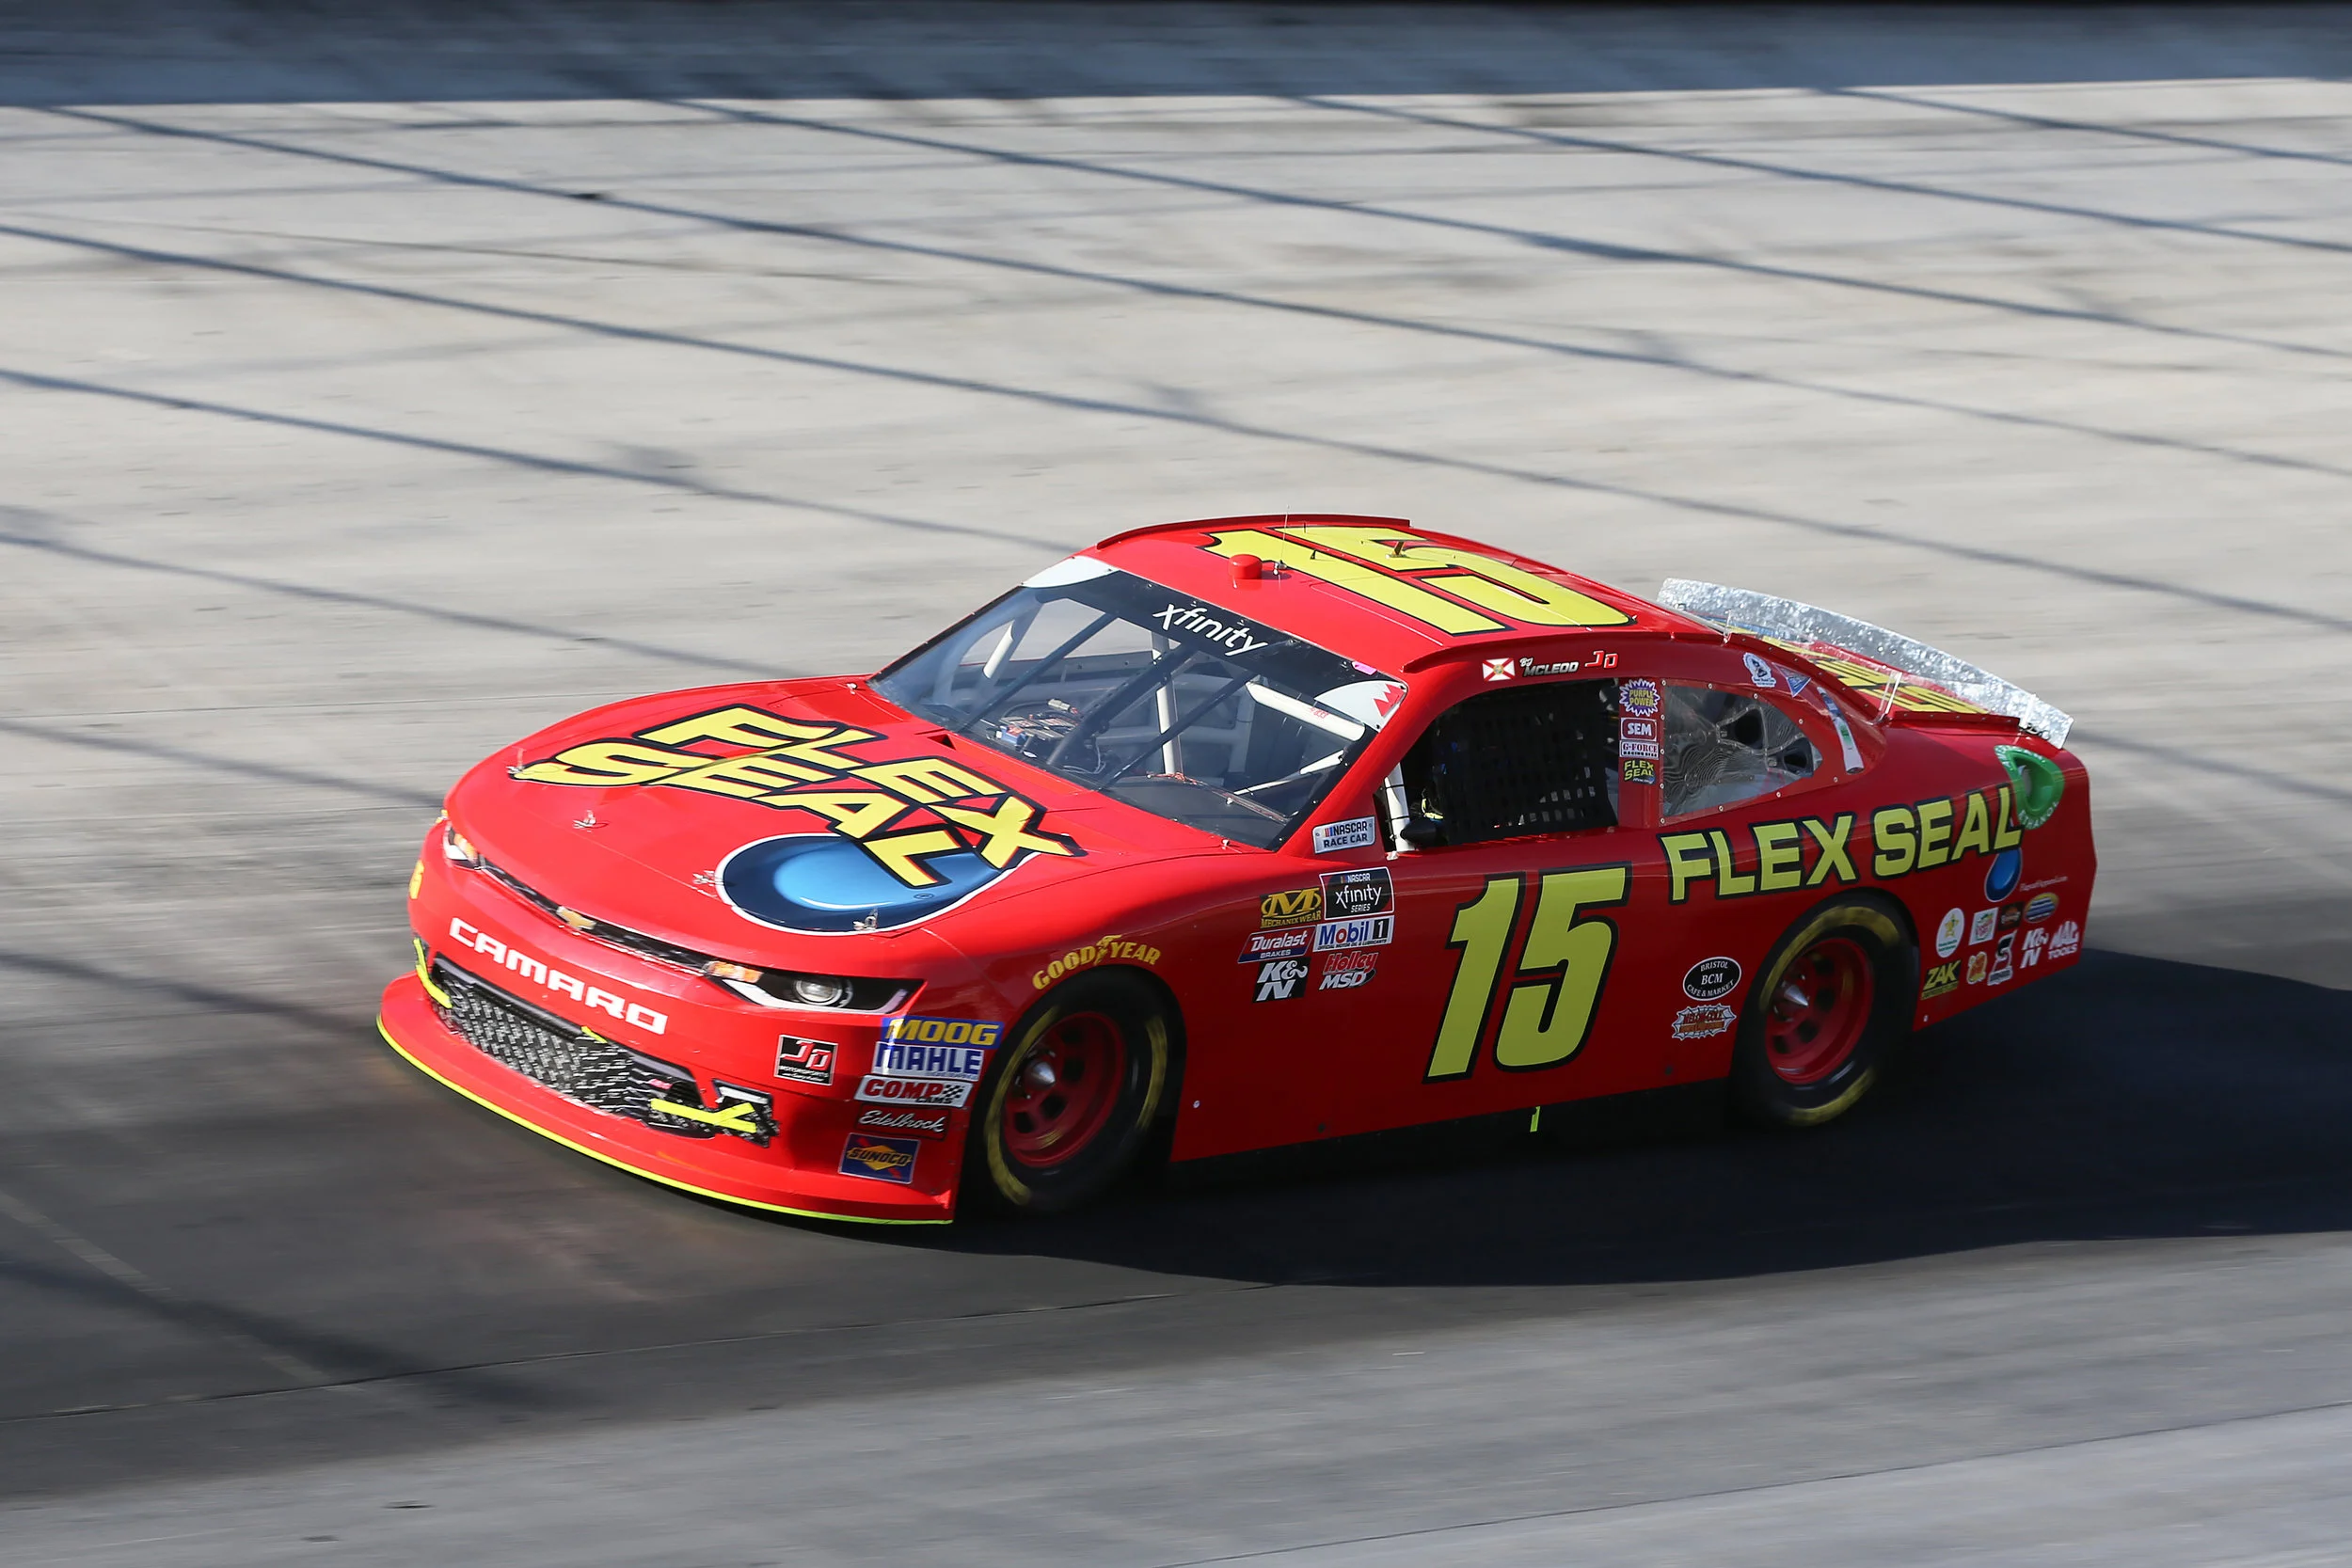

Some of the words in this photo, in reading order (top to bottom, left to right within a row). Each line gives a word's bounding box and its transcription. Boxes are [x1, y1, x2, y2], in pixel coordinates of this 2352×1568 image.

[1199, 523, 1635, 636] 15
[1152, 603, 1268, 657] xfinity
[1523, 661, 1580, 676] MCLEOD
[1584, 650, 1619, 669] JD
[1629, 689, 1653, 699] PURPLE
[1629, 697, 1654, 706] POWER
[1627, 722, 1652, 736] SEM
[1622, 743, 1658, 752] G-FORCE
[1624, 760, 1655, 771] FLEX
[1624, 768, 1654, 781] SEAL
[632, 703, 1080, 871] FLEX
[511, 736, 964, 890] SEAL
[1332, 820, 1368, 836] NASCAR
[1323, 834, 1349, 848] RACE
[1350, 832, 1368, 844] CAR
[1661, 816, 1857, 901] FLEX
[1875, 786, 2023, 877] SEAL
[1347, 872, 1371, 883] NASCAR
[1335, 885, 1382, 910] xfinity
[1350, 903, 1371, 913] SERIES
[1261, 918, 1299, 928] MECHANIX
[1298, 910, 1322, 924] WEAR
[1250, 930, 1308, 953] Duralast
[1318, 920, 1370, 946] Mobil
[1260, 949, 1291, 959] BRAKES
[2048, 943, 2077, 959] TOOLS
[1032, 935, 1161, 990] GOODYEAR
[1323, 951, 1379, 974] Holley
[1700, 960, 1728, 972] BRISTOL
[449, 917, 668, 1035] CAMARO
[1319, 973, 1366, 990] MSD
[1424, 863, 1631, 1082] 15
[1701, 973, 1724, 986] BCM
[1925, 960, 1961, 989] ZAK
[1707, 979, 1734, 997] MARKET
[885, 1018, 999, 1046] MOOG
[780, 1039, 833, 1071] JD
[876, 1042, 982, 1074] MAHLE
[864, 1079, 945, 1100] COMP
[916, 1096, 953, 1104] CAMS
[858, 1110, 946, 1132] Edelbrock
[850, 1148, 912, 1164] SUNOCO
